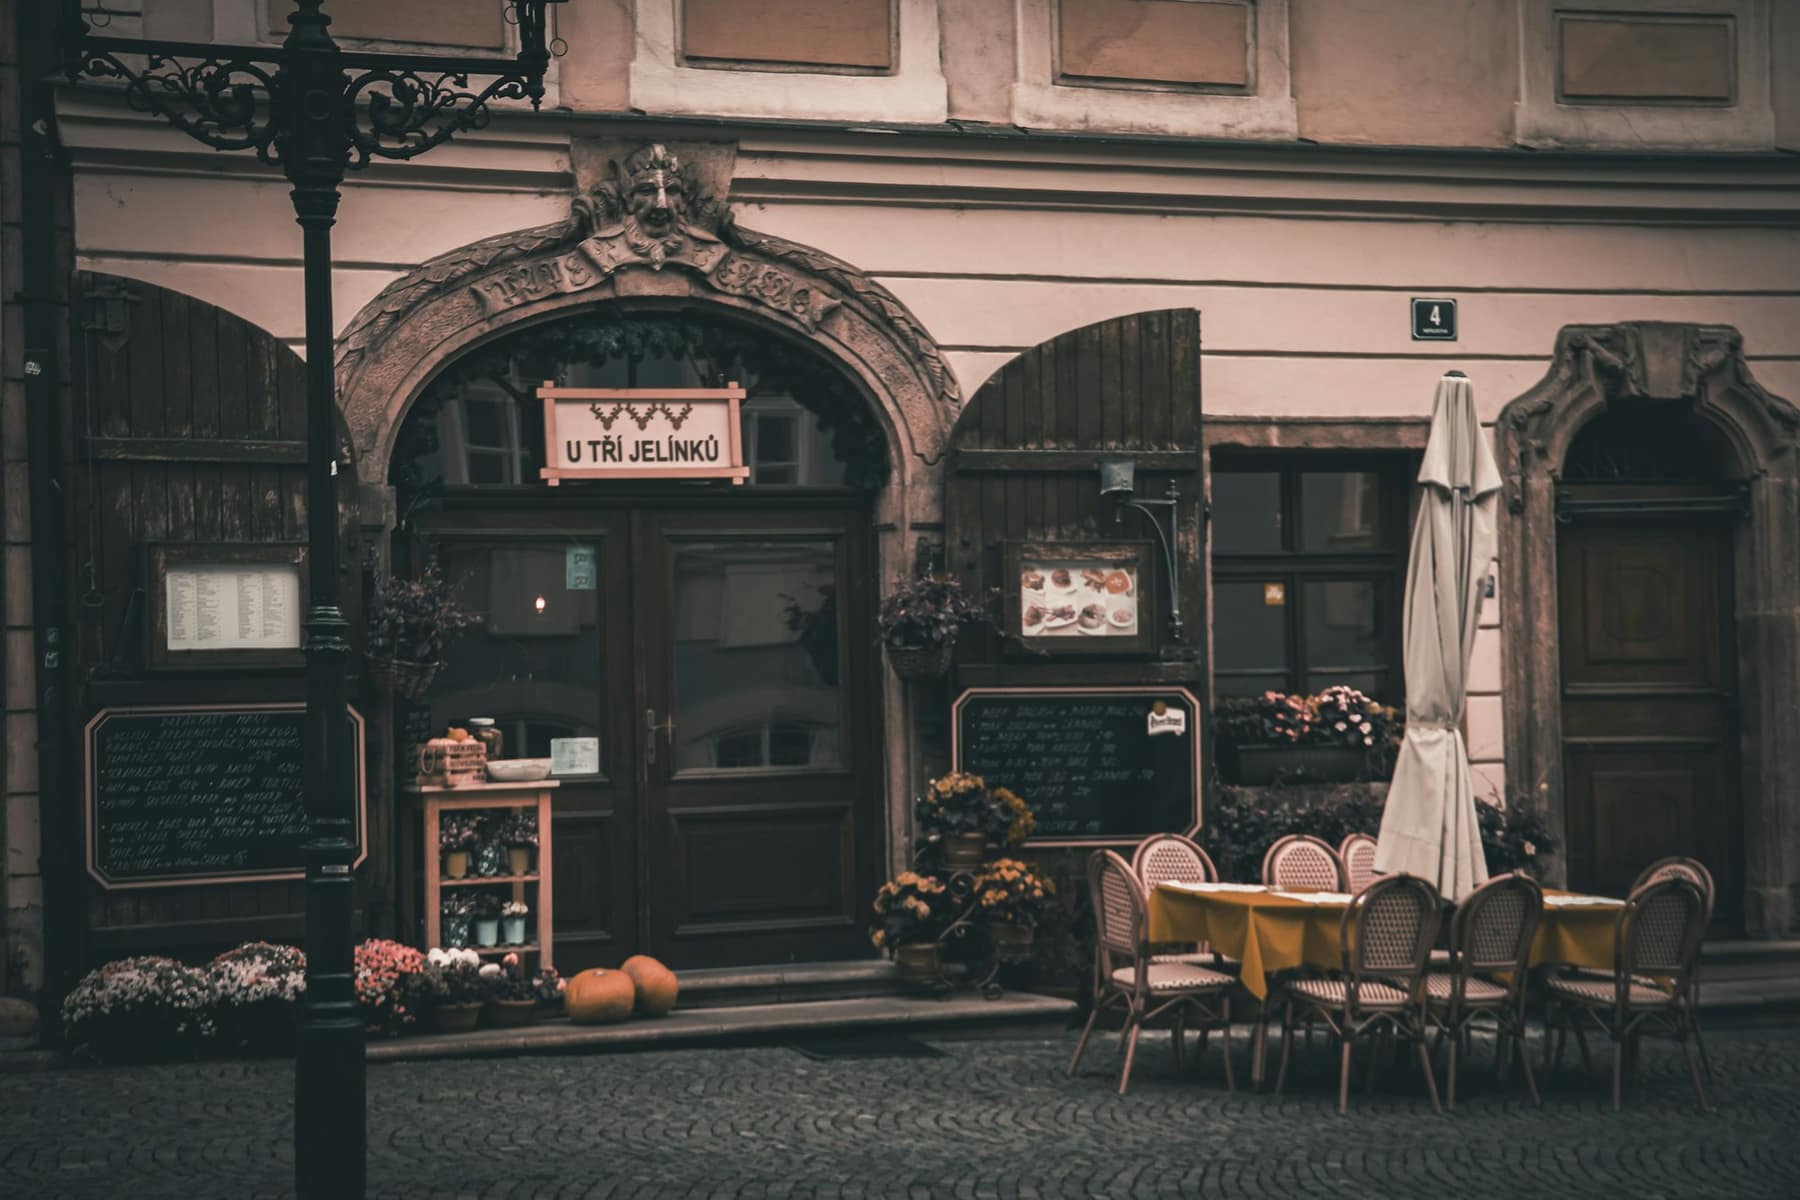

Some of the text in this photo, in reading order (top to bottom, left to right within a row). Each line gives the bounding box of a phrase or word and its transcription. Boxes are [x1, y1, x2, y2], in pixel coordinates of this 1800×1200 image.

[1430, 305, 1441, 326] 4
[567, 434, 719, 462] U TŘÍ JELÍNKŮ
